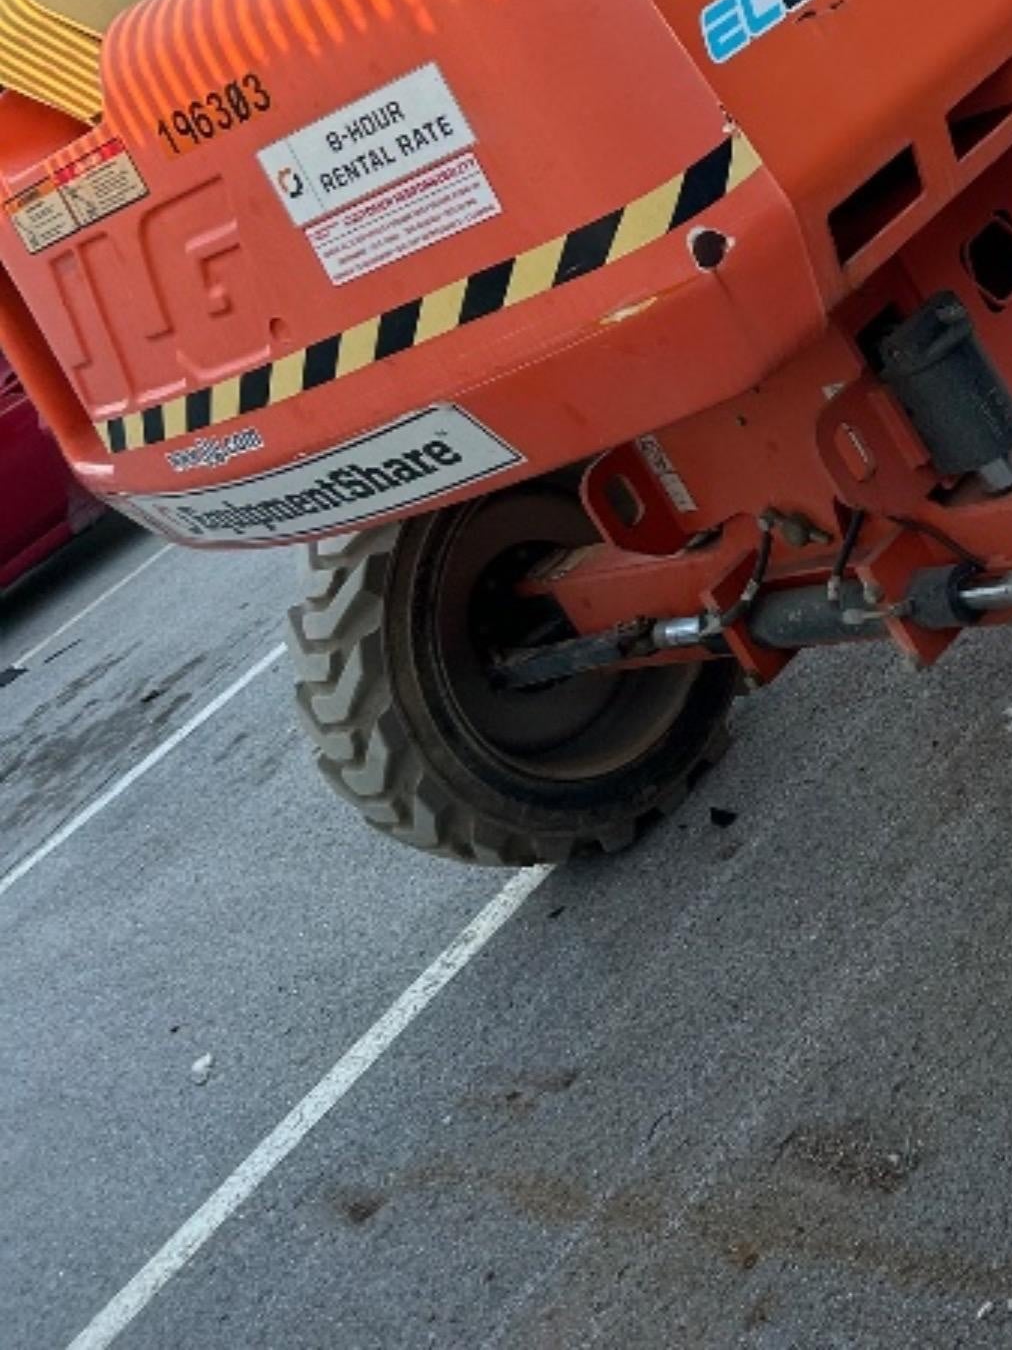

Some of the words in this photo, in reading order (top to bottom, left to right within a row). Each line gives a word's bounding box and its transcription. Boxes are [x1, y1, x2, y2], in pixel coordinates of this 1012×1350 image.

[157, 73, 272, 155] 196303
[320, 144, 397, 193] RENTAL
[395, 114, 455, 157] RATE
[325, 100, 406, 153] 8-HOUR
[190, 438, 464, 536] EquipmentShare
